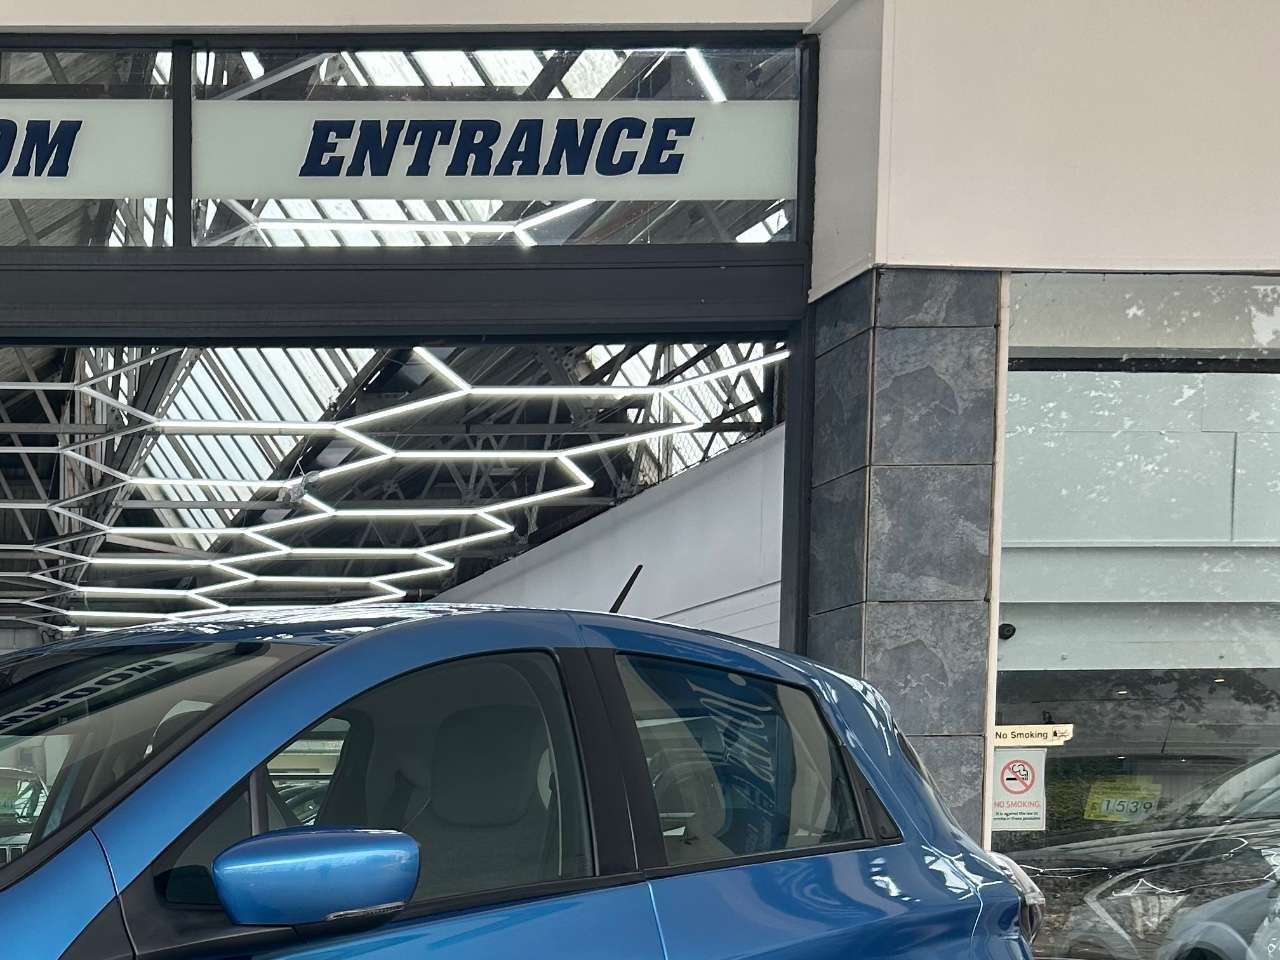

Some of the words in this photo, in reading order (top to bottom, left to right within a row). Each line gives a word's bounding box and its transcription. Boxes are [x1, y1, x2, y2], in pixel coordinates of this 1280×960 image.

[298, 116, 696, 177] ENTRANCE
[995, 731, 1008, 739] No
[1011, 731, 1048, 740] Smoking
